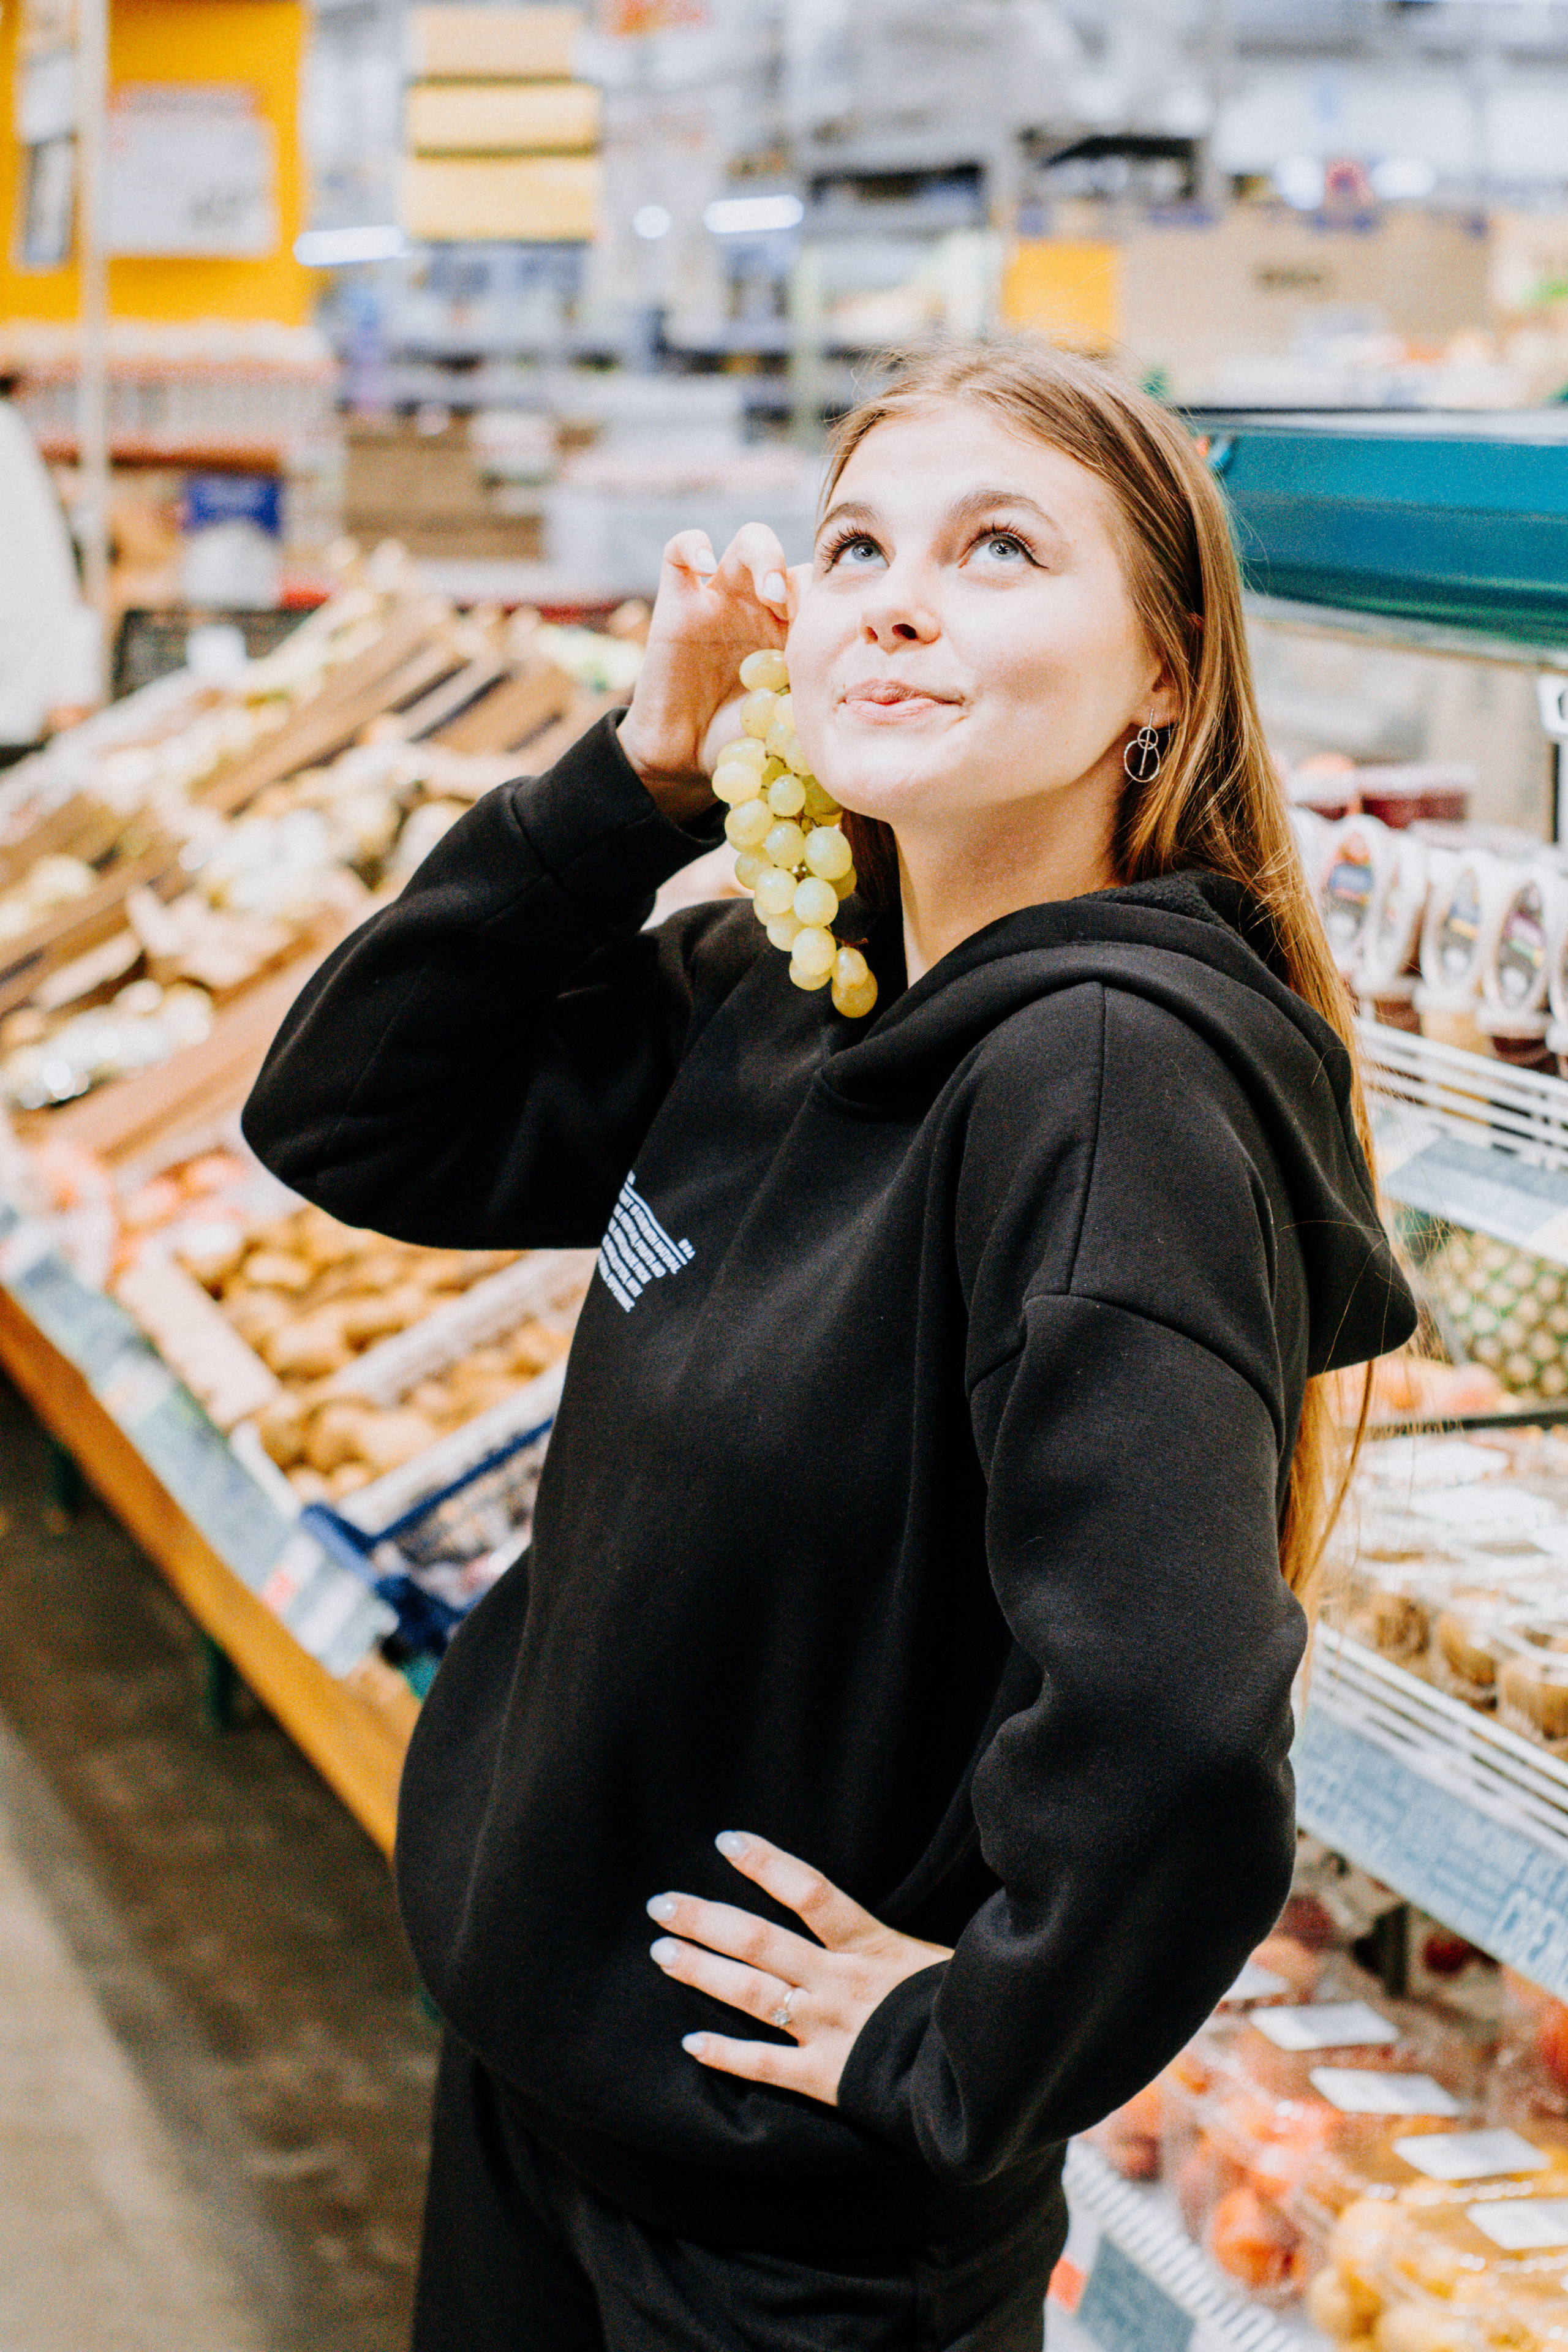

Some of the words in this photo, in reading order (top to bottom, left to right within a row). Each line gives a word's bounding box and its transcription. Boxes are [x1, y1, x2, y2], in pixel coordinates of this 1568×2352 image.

[631, 1239, 656, 1266] FRUITS
[649, 1261, 666, 1278] AND
[653, 1240, 681, 1274] NATURAL
[632, 1262, 652, 1284] FROM
[624, 1278, 643, 1297] WITH
